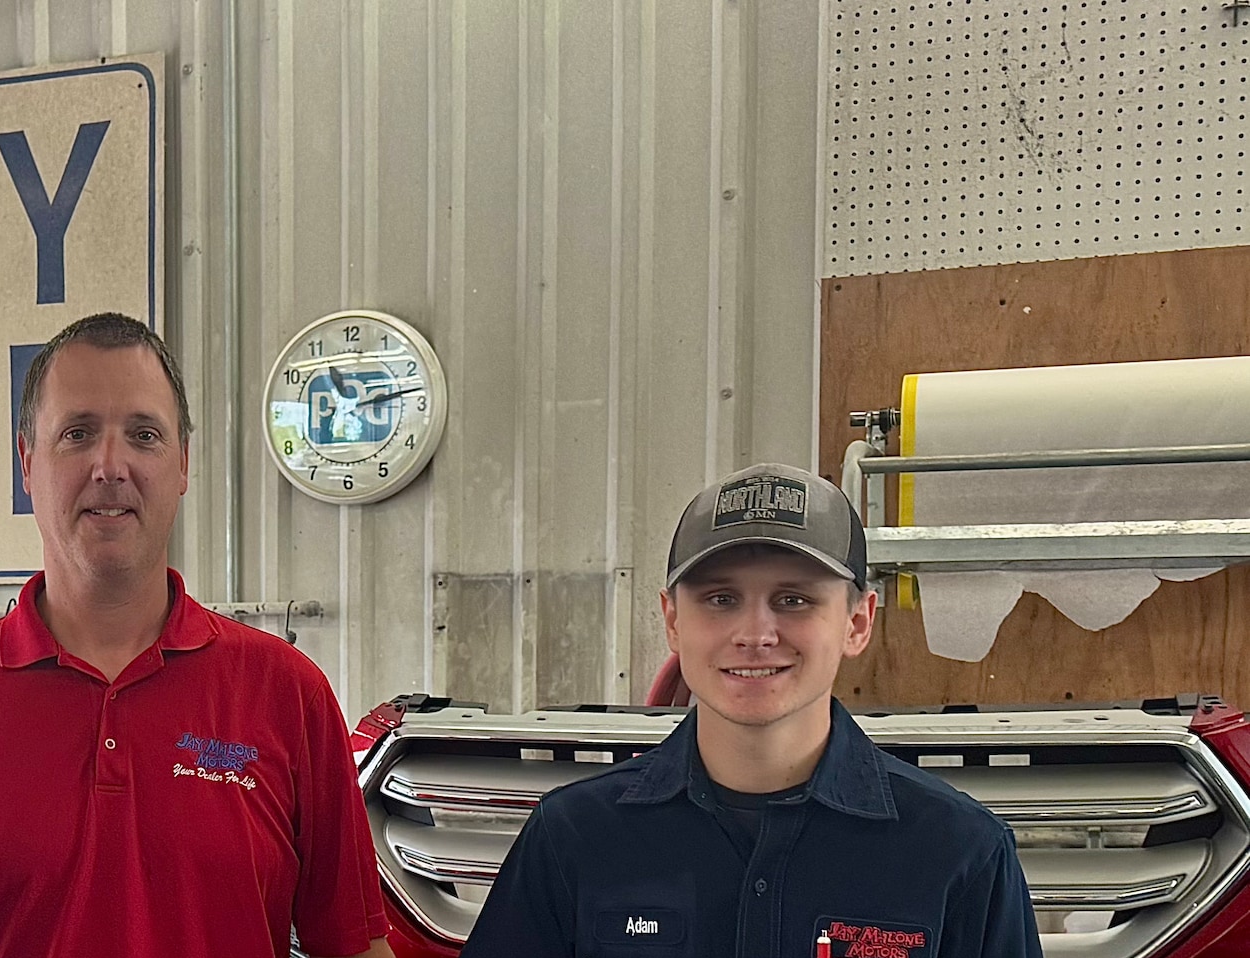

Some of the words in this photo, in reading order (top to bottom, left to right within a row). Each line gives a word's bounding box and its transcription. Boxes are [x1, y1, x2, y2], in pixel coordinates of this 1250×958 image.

[343, 326, 360, 342] 12
[308, 341, 324, 356] 11
[380, 335, 389, 350] 1
[283, 369, 300, 385] 10
[406, 361, 417, 377] 2
[417, 396, 427, 411] 3
[284, 440, 293, 455] 8
[404, 434, 415, 449] 4
[308, 465, 318, 481] 7
[378, 462, 389, 478] 5
[343, 474, 354, 490] 6
[717, 484, 805, 516] NORTHLAND
[173, 763, 196, 778] Your
[197, 767, 223, 782] Dealer
[225, 771, 239, 784] For
[239, 775, 257, 790] Life
[625, 916, 658, 936] Adam
[828, 922, 861, 941] JAY
